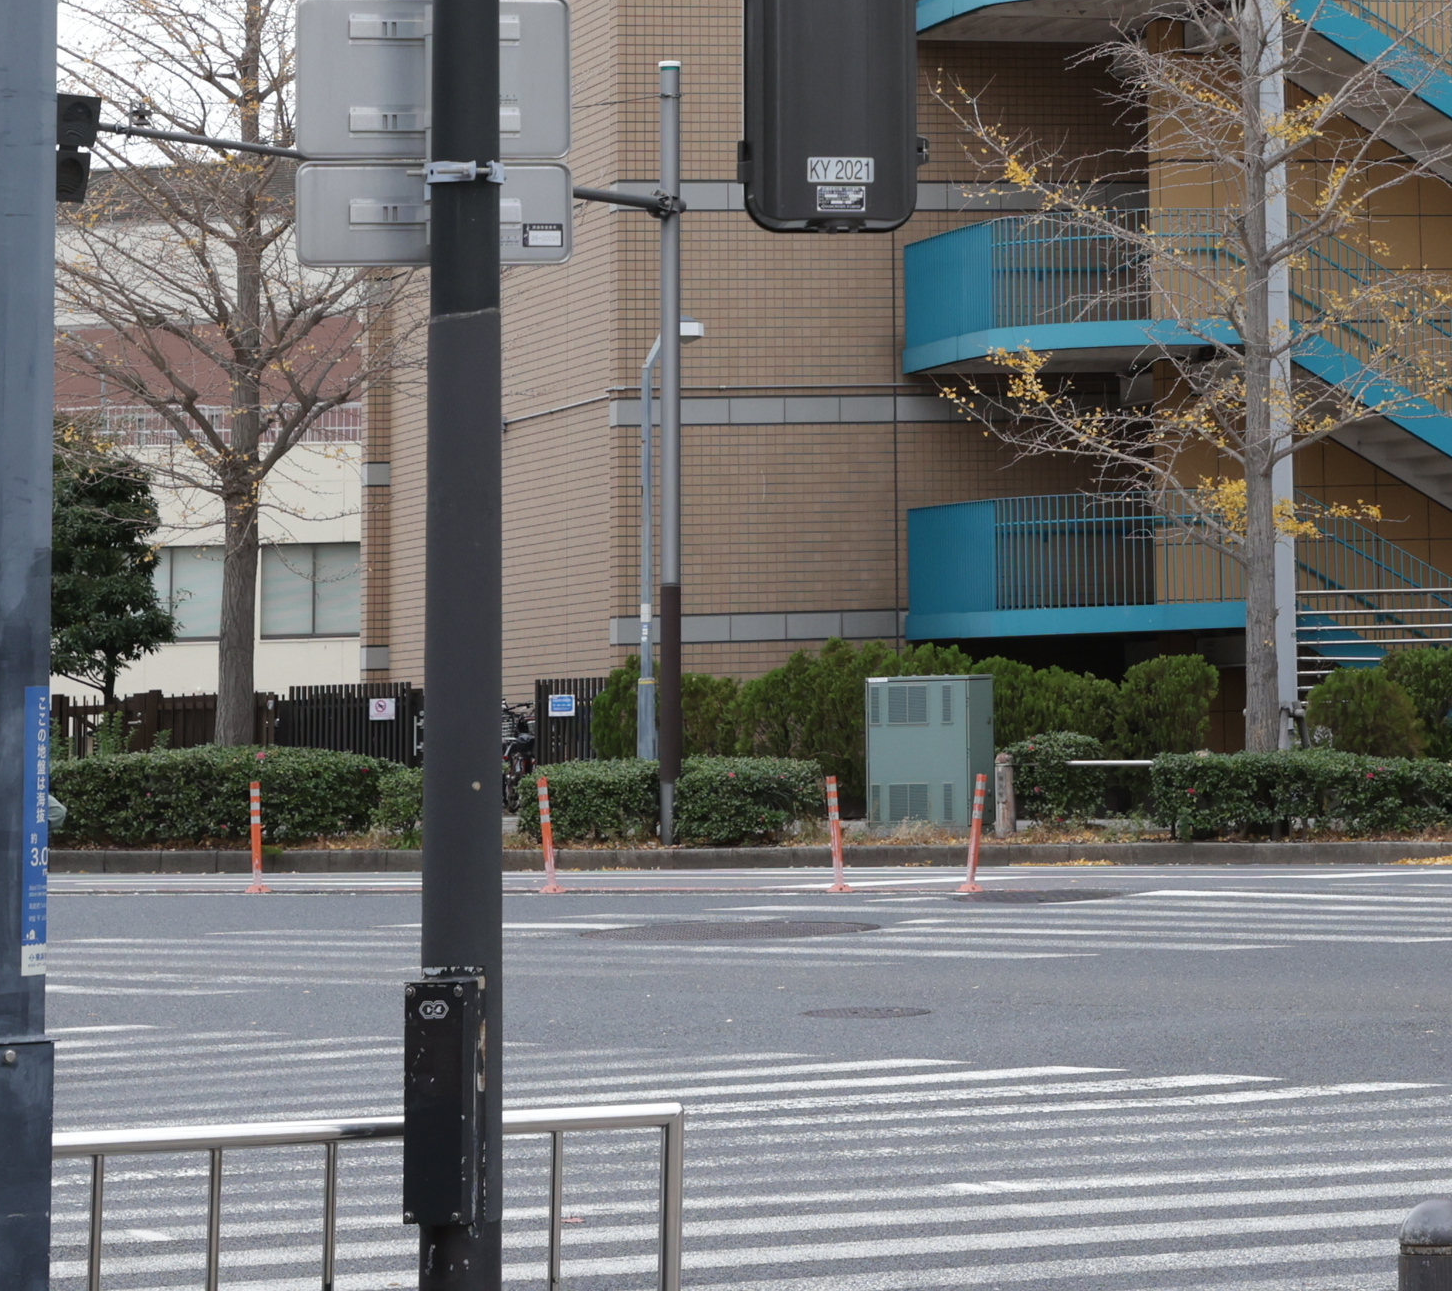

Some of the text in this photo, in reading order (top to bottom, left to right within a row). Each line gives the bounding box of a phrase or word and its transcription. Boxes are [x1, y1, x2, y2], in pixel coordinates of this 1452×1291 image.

[810, 160, 869, 180] KY 2021
[36, 697, 46, 823] ここの地盤は海抜
